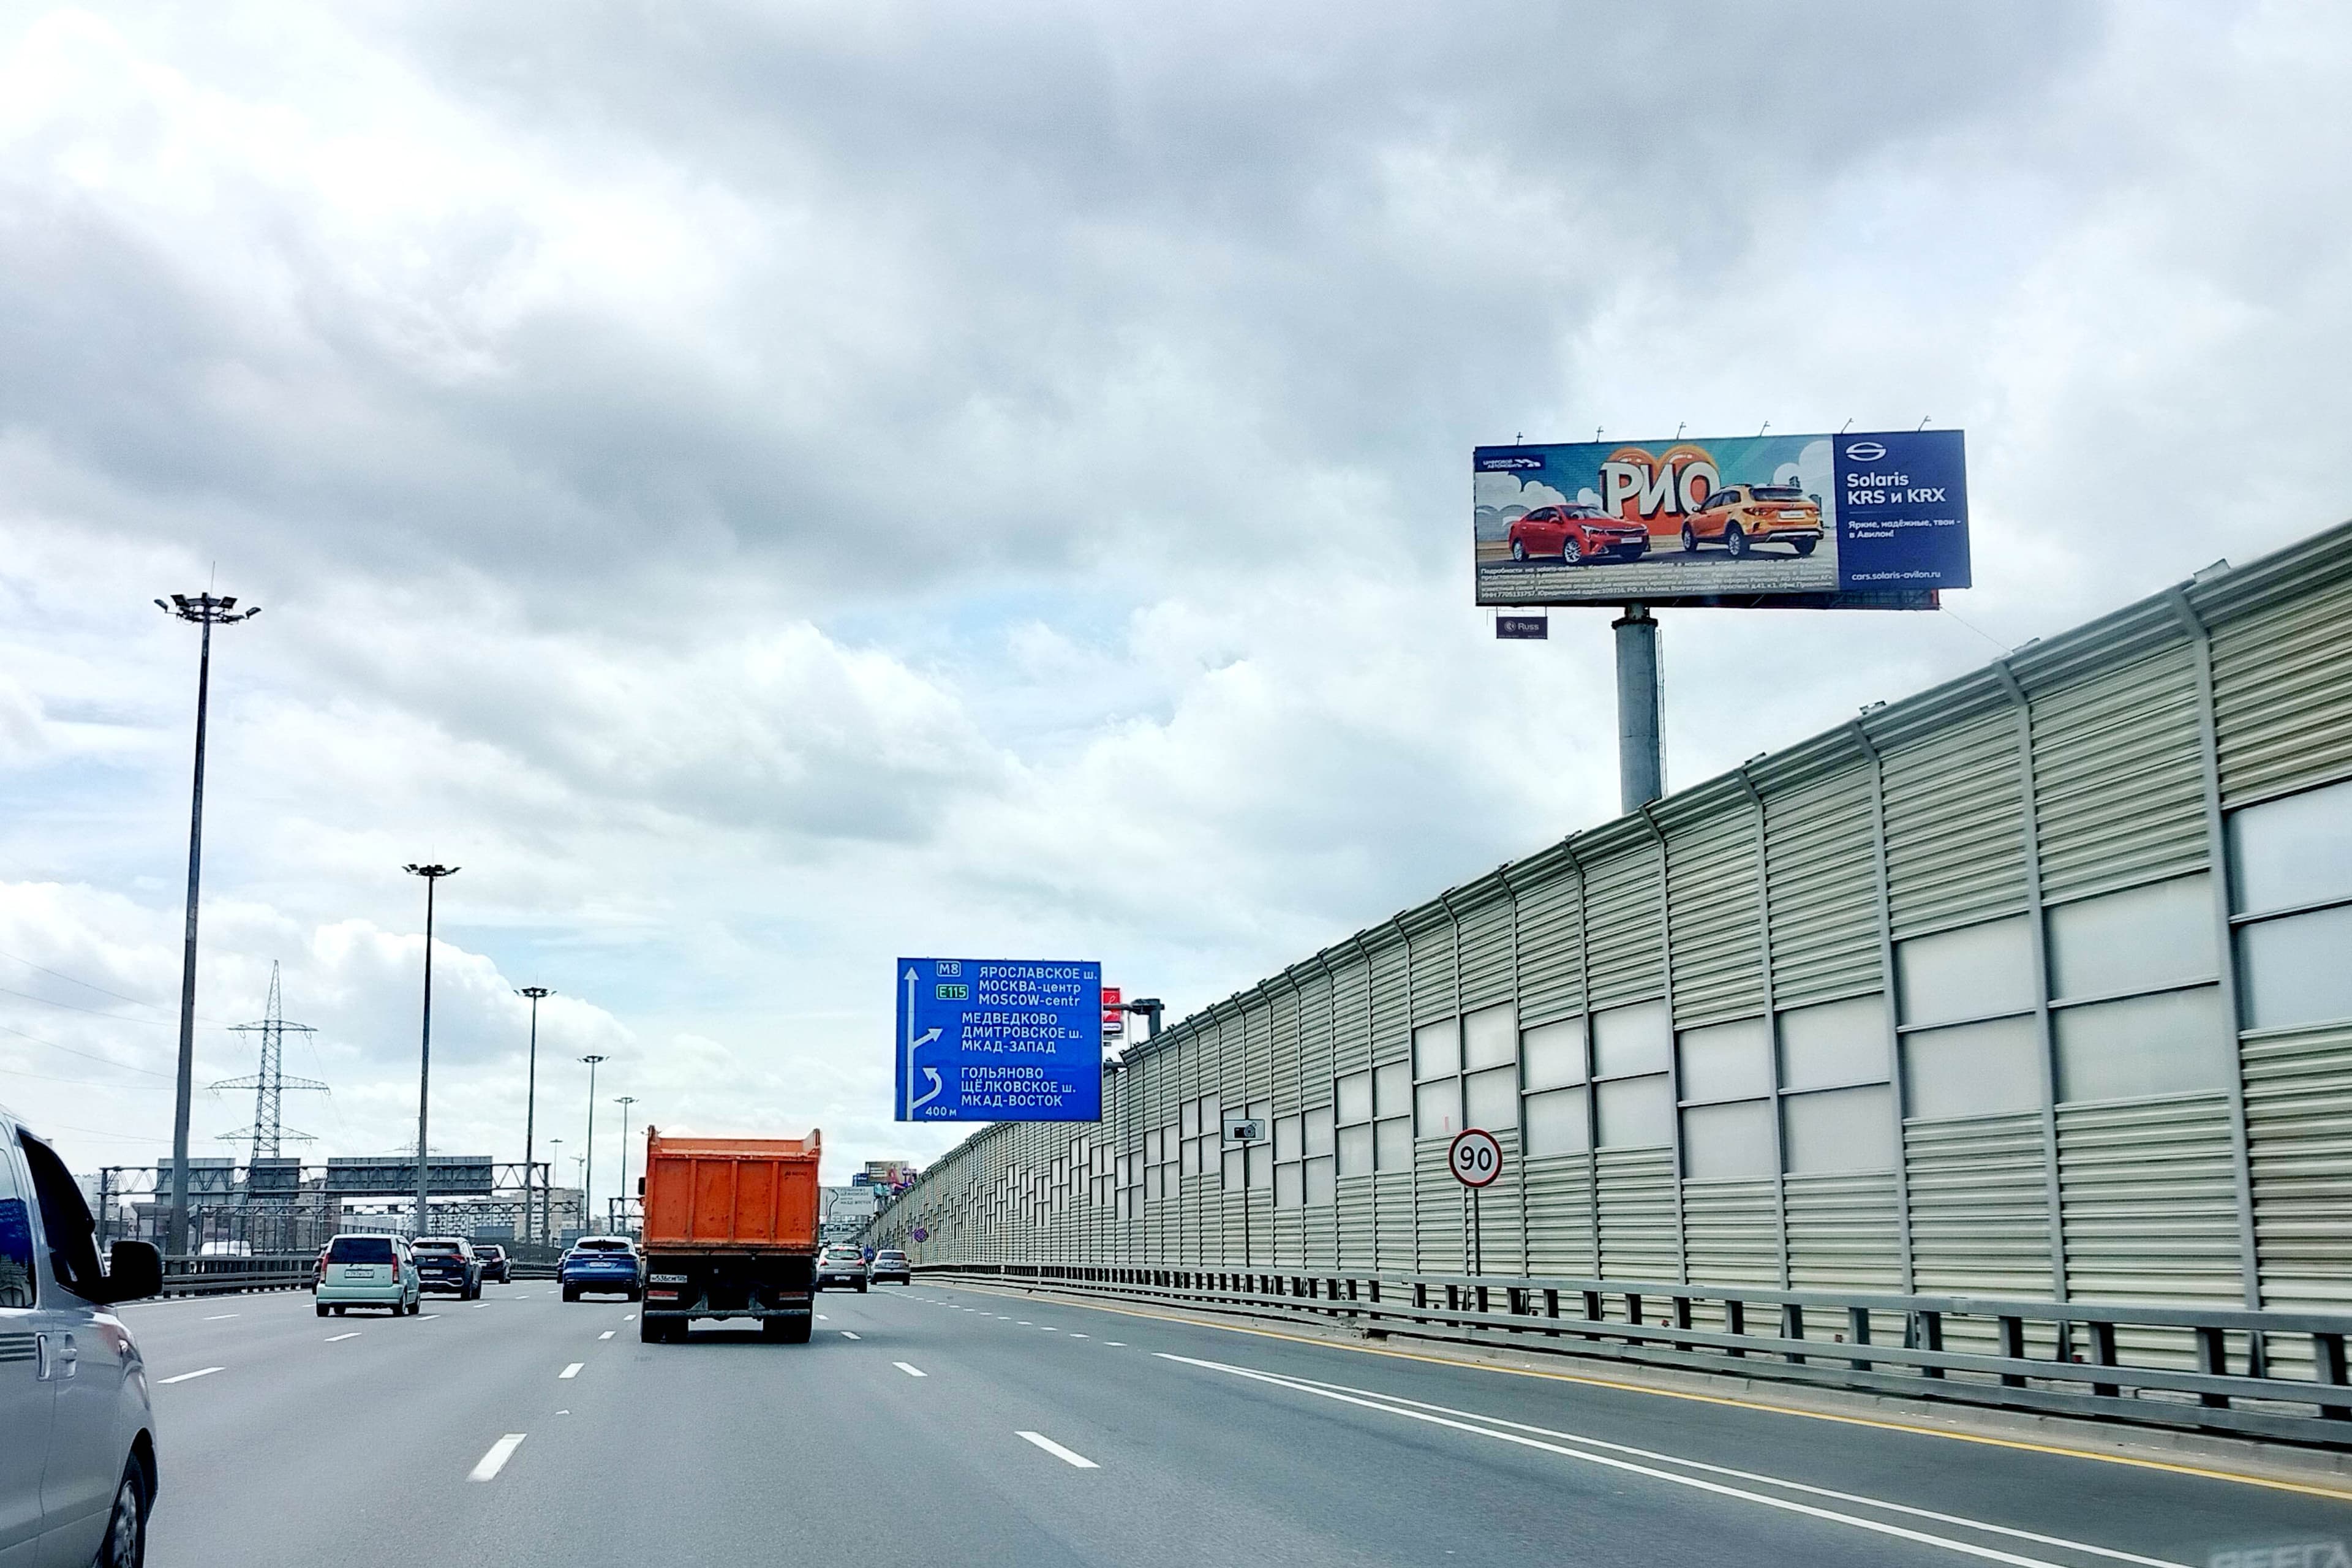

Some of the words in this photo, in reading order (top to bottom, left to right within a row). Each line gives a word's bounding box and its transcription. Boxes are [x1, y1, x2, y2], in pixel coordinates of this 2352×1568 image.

[1847, 472, 1909, 488] Solaris
[1600, 461, 1721, 519] РИО
[1847, 490, 1886, 505] KRS
[1891, 492, 1902, 503] и
[1907, 488, 1947, 503] KRX
[1849, 521, 1880, 530] Яркие,
[1881, 519, 1932, 529] надёжные,
[1857, 530, 1894, 538] Авилон!
[1852, 571, 1941, 581] cars.solaris-avilon.ru
[980, 967, 1080, 979] ЯРОСЛАВСКОЕ
[1084, 971, 1098, 980] ш.
[939, 986, 966, 998] E115
[979, 980, 1081, 995] МОСКВА-центр
[979, 993, 1080, 1006] MOSCOW-centr
[962, 1012, 1058, 1026] МЕДВЕДКОВО
[962, 1026, 1066, 1038] ДМИТРОВСКОЕ
[1069, 1030, 1083, 1039] ш.
[961, 1040, 1056, 1054] МКАД-ЗАПАД
[961, 1067, 1044, 1079] ГОЛЬЯНОВО
[961, 1079, 1058, 1093] ЩЁЛКОВСКОЕ
[1062, 1084, 1076, 1093] ш.
[961, 1095, 1063, 1107] МКАД-ВОСТОК
[925, 1106, 947, 1116] 400
[1460, 1145, 1492, 1171] 90
